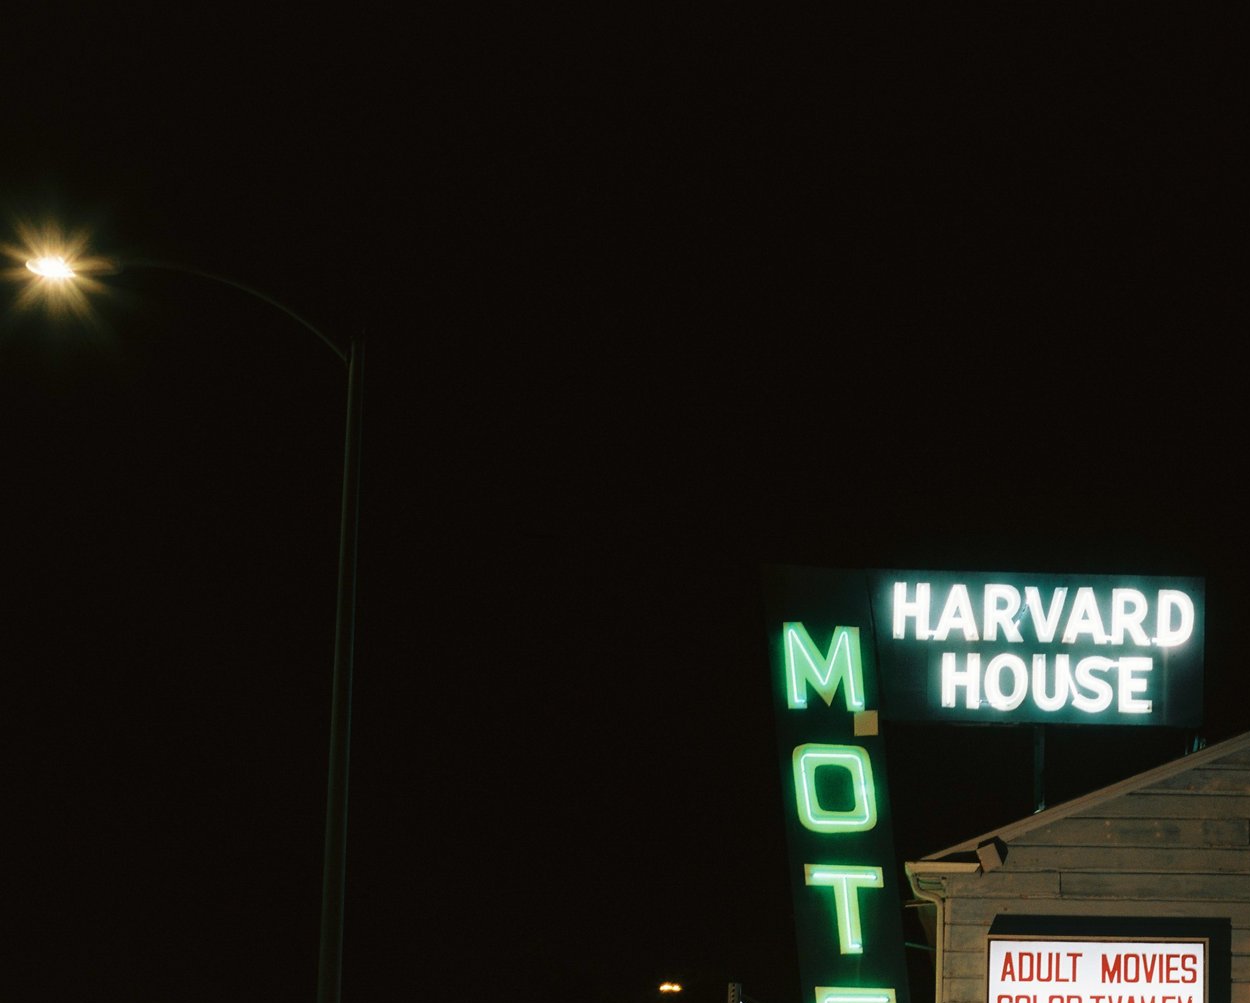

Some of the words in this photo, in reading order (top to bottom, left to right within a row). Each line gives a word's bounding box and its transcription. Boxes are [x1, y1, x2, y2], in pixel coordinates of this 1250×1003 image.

[893, 582, 1195, 648] HARVARD
[940, 652, 1153, 714] HOUSE
[1001, 951, 1083, 982] ADULT
[1101, 953, 1198, 984] MOVIES
